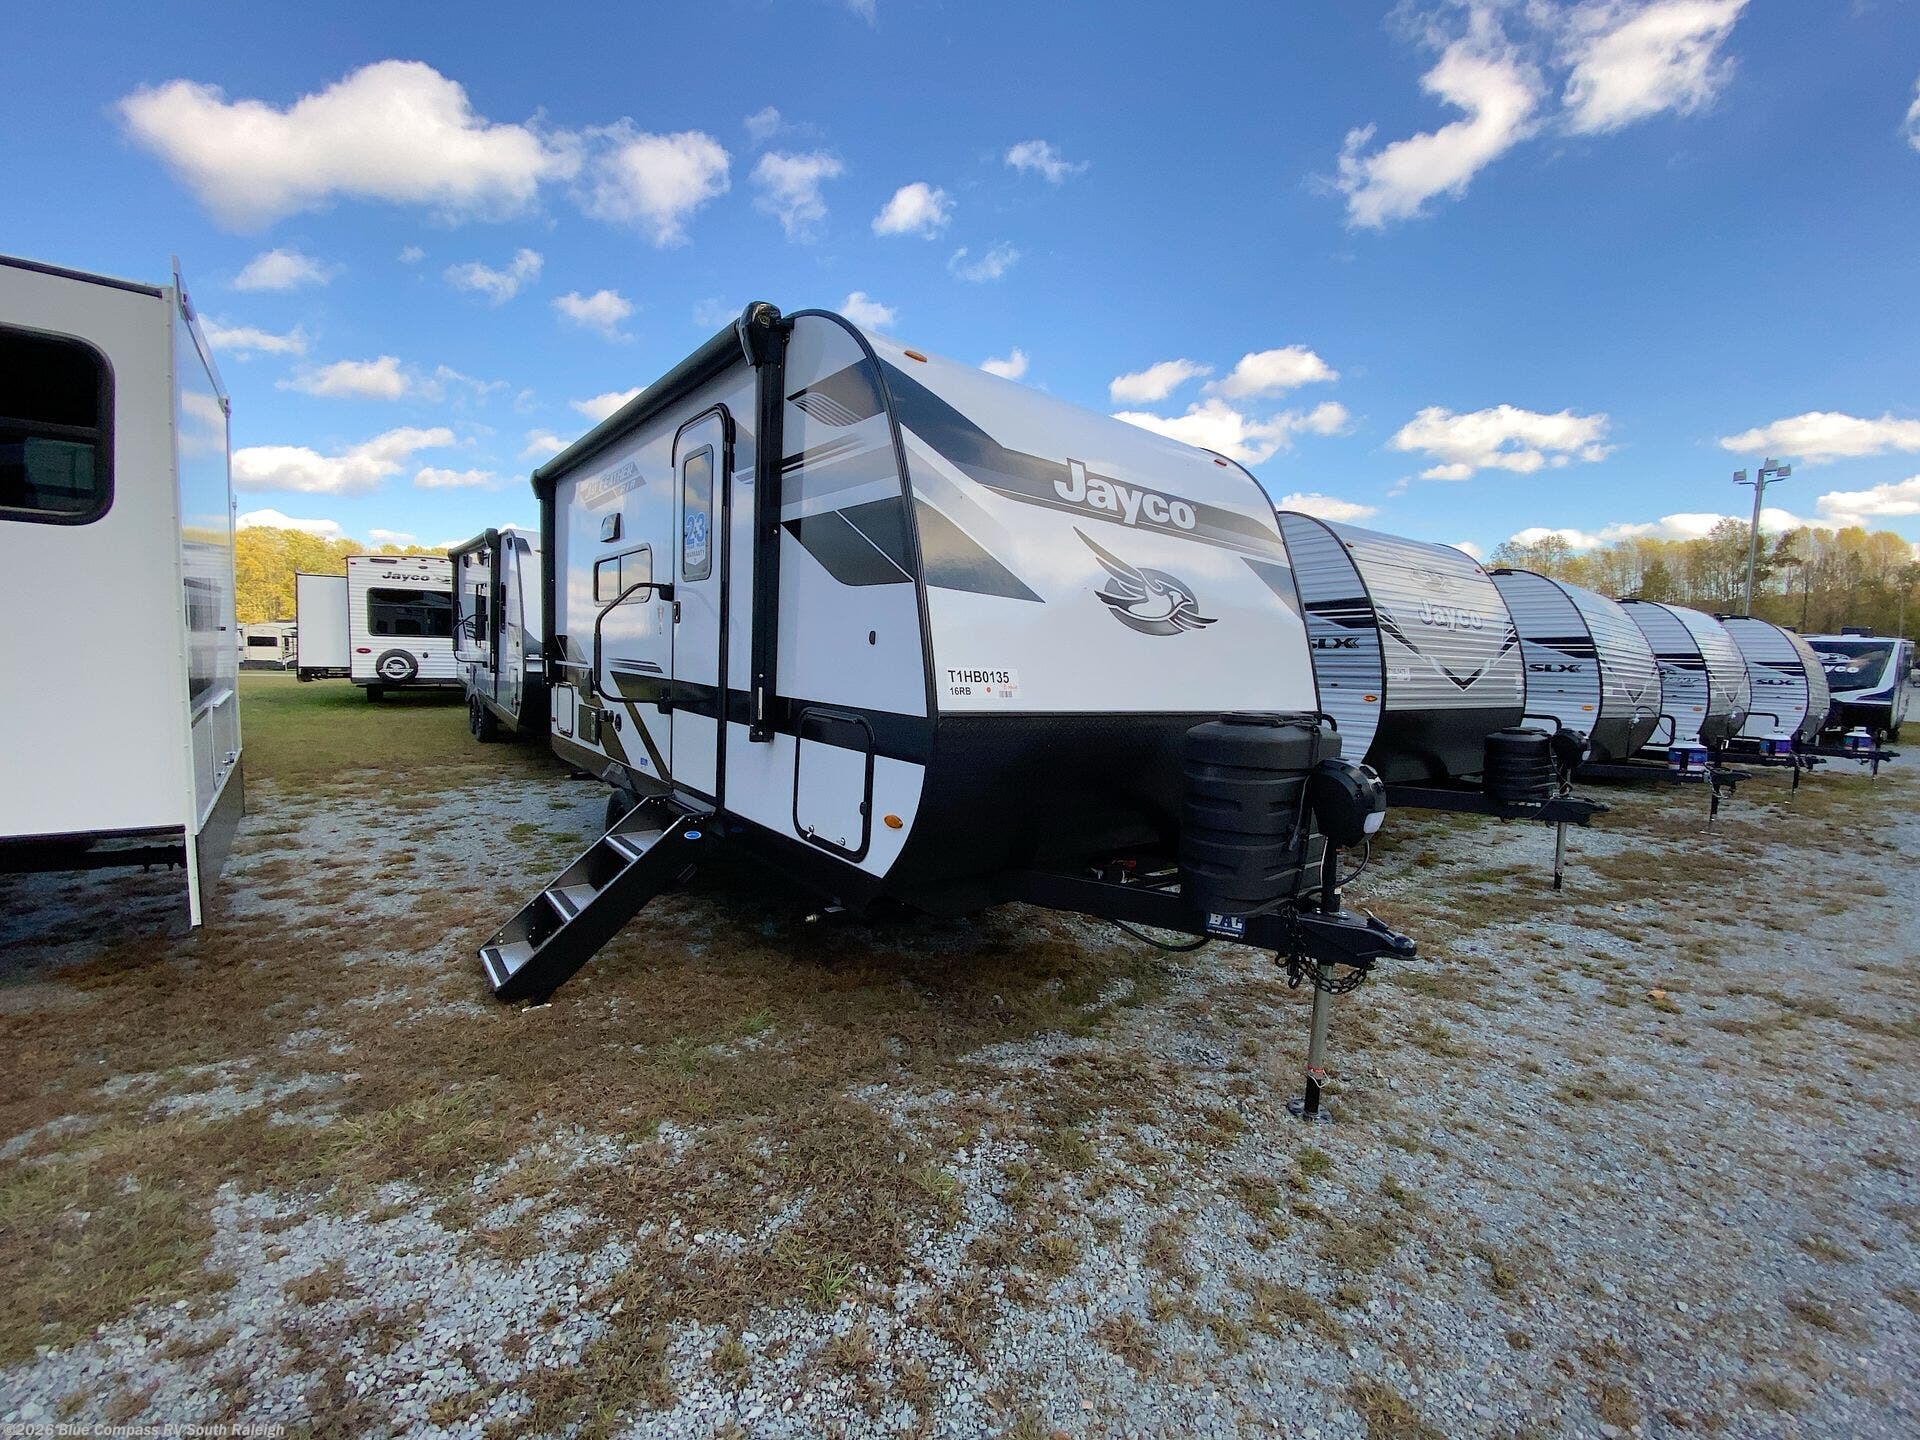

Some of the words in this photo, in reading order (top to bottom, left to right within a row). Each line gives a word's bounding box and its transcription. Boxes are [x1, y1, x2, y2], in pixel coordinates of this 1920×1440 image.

[1053, 458, 1196, 530] Jayco
[382, 571, 430, 581] Jayco
[1418, 599, 1484, 631] Jayco
[1823, 665, 1860, 674] yco
[948, 670, 1010, 684] T1HB0135
[949, 687, 971, 696] 16RB
